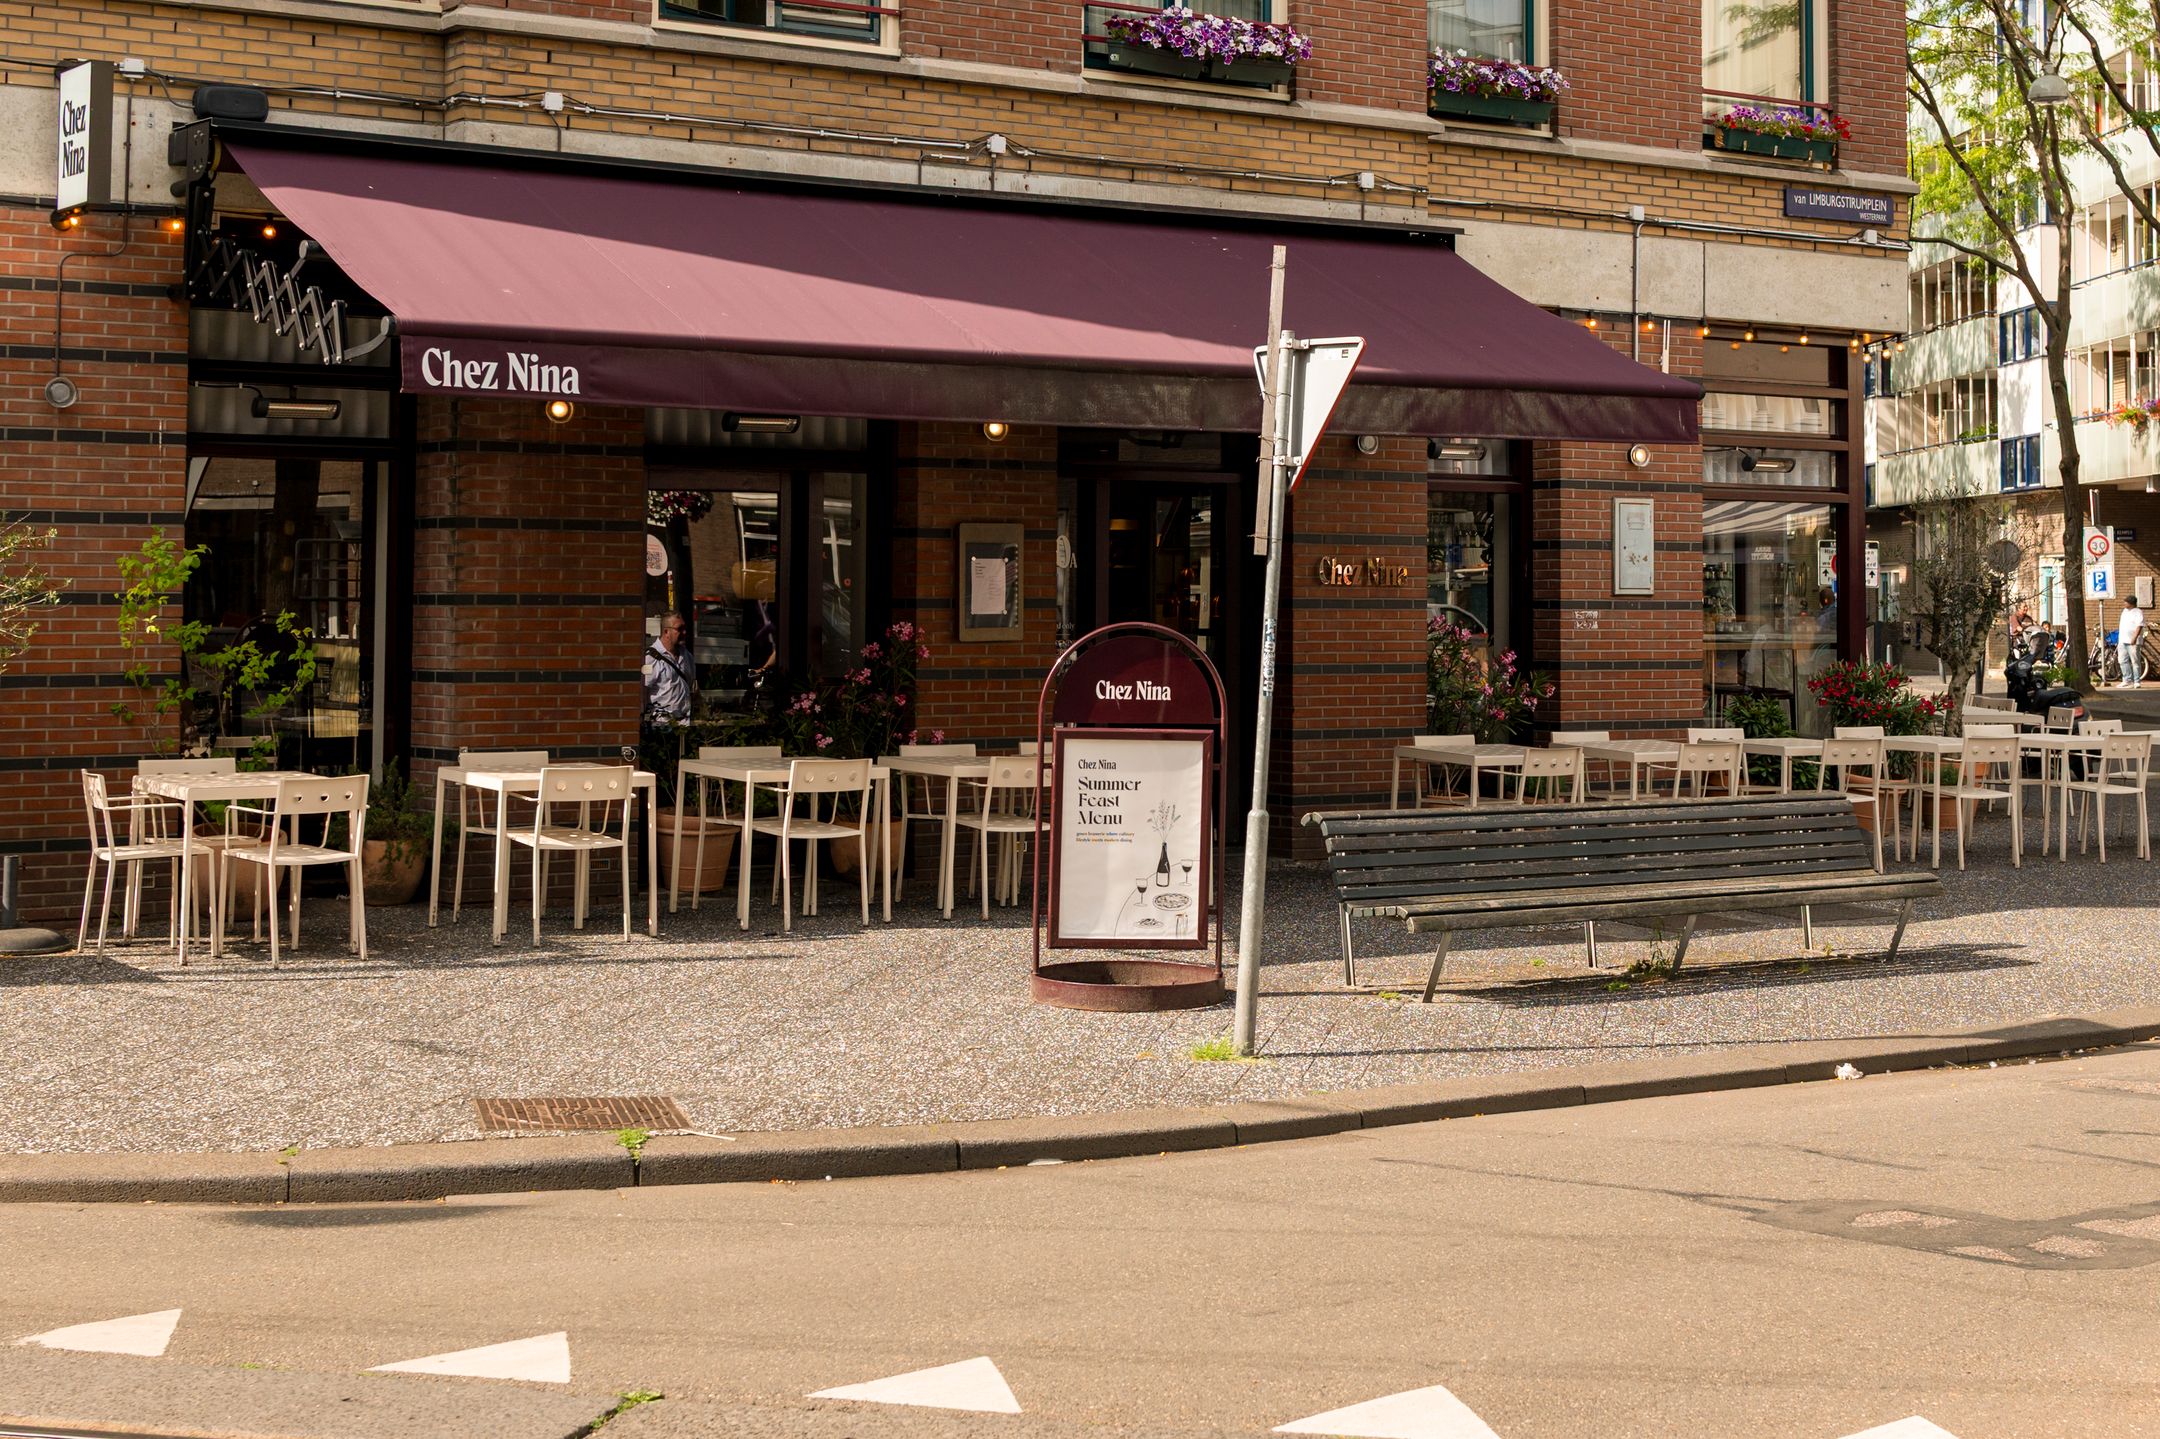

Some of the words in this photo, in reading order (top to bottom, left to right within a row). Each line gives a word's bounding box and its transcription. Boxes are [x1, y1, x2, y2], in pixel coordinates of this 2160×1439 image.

[63, 100, 87, 137] Chez
[62, 140, 85, 178] Nina
[1794, 195, 1806, 204] van
[1809, 193, 1887, 212] LIMBURGSTIRUMPLEIN
[1859, 212, 1888, 222] WESTERPARK
[421, 347, 499, 390] Chez
[506, 352, 581, 395] Nina
[2092, 541, 2106, 551] 30
[1319, 556, 1363, 586] Chez
[1367, 556, 1408, 586] Nina
[1095, 680, 1133, 700] Chez
[1135, 680, 1172, 701] Nina
[1078, 759, 1097, 770] Chez
[1098, 759, 1117, 770] Nina
[1078, 776, 1142, 791] Summer
[1078, 793, 1120, 807] Feast
[1078, 810, 1122, 825] Menu
